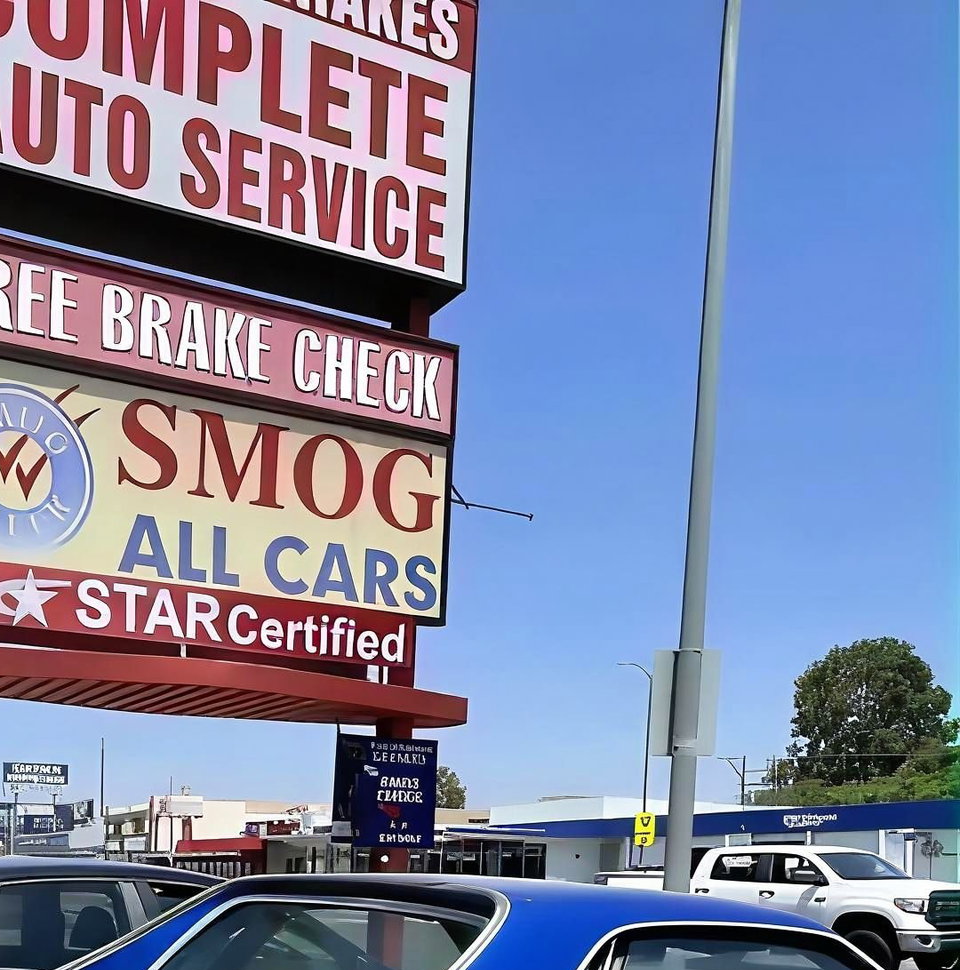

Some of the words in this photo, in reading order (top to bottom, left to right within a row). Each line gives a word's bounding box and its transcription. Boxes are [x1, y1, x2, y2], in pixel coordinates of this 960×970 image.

[297, 0, 459, 60] AKES
[180, 117, 447, 272] SERVICE
[101, 283, 272, 383] BRAKE
[292, 328, 442, 421] CHECK
[118, 398, 442, 533] SMOG
[117, 513, 240, 587] ALL
[264, 535, 438, 611] CARS
[75, 578, 223, 643] STAR
[227, 604, 405, 664] Certified
